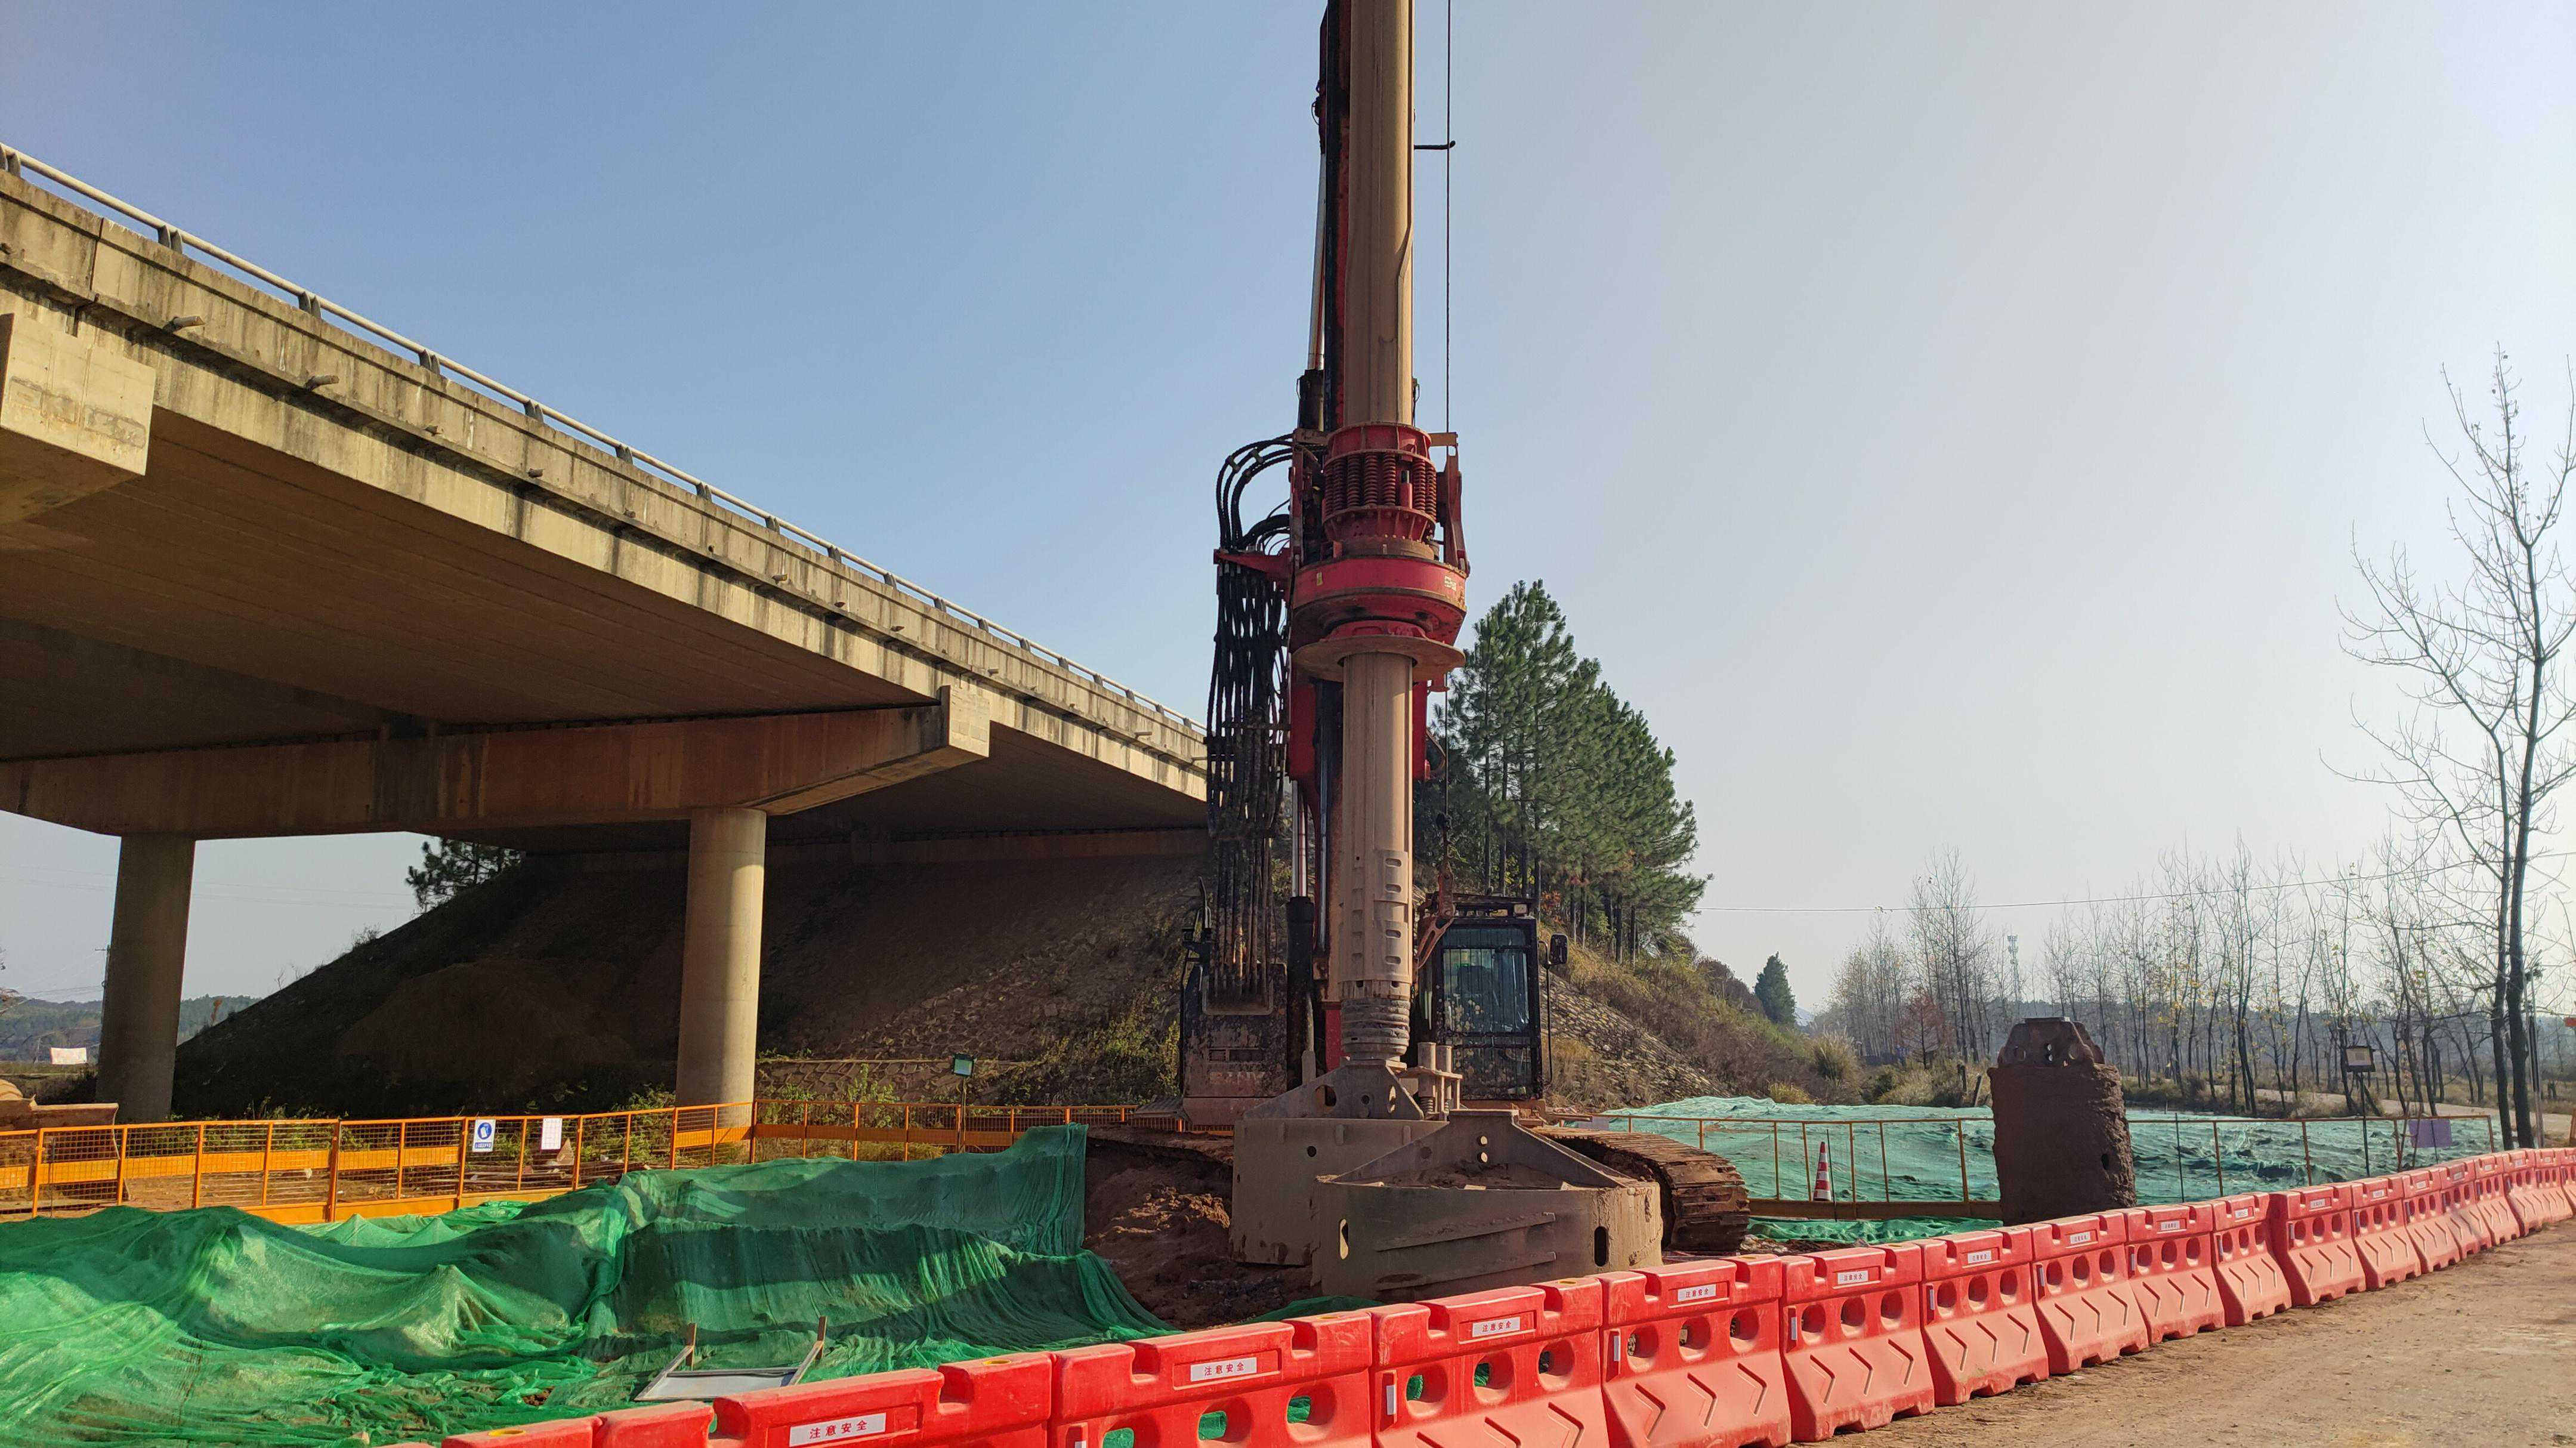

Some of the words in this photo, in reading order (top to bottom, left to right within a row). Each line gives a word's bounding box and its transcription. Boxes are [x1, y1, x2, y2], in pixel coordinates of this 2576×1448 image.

[1482, 1320, 1512, 1332] 注意安全
[1204, 1362, 1244, 1376] 注意安全
[809, 1420, 867, 1439] 注意安全
